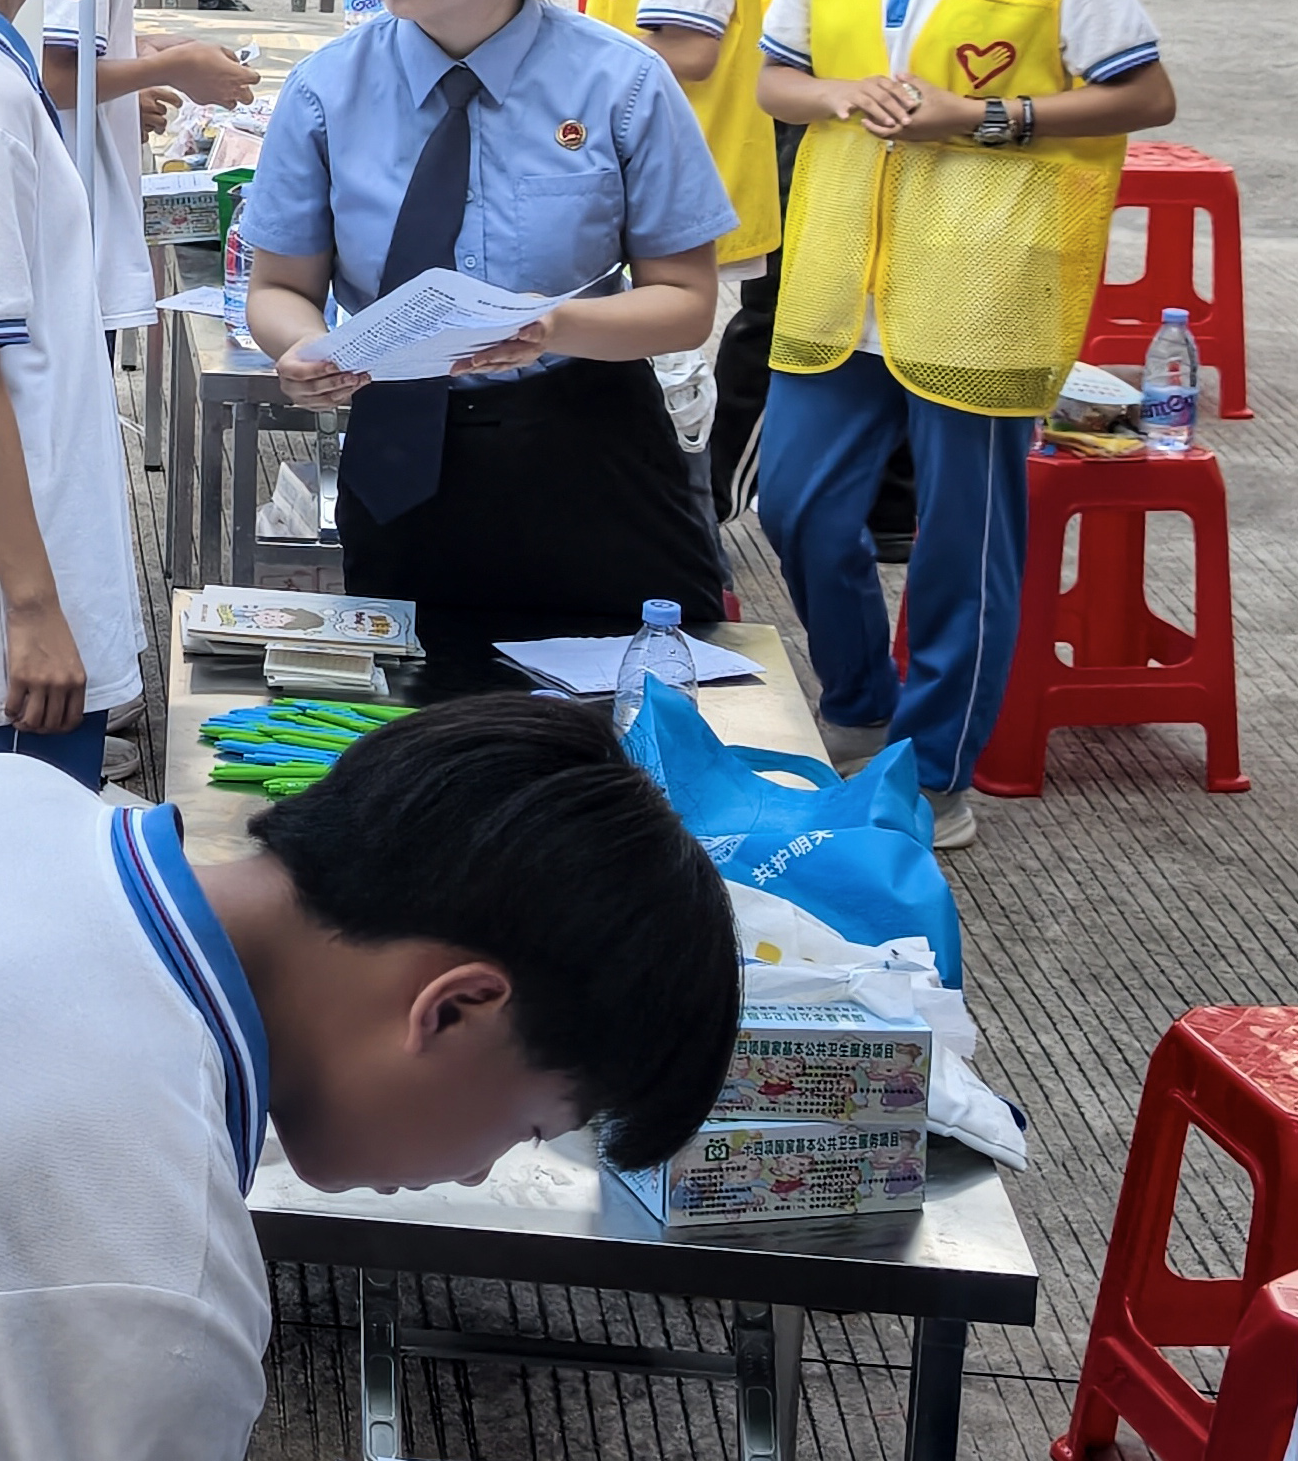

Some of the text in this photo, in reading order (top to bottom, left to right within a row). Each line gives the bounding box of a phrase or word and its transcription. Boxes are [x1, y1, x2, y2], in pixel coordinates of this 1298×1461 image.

[751, 829, 835, 887] 共护明天
[735, 1040, 895, 1059] 四项国家基本公共卫生服务项目
